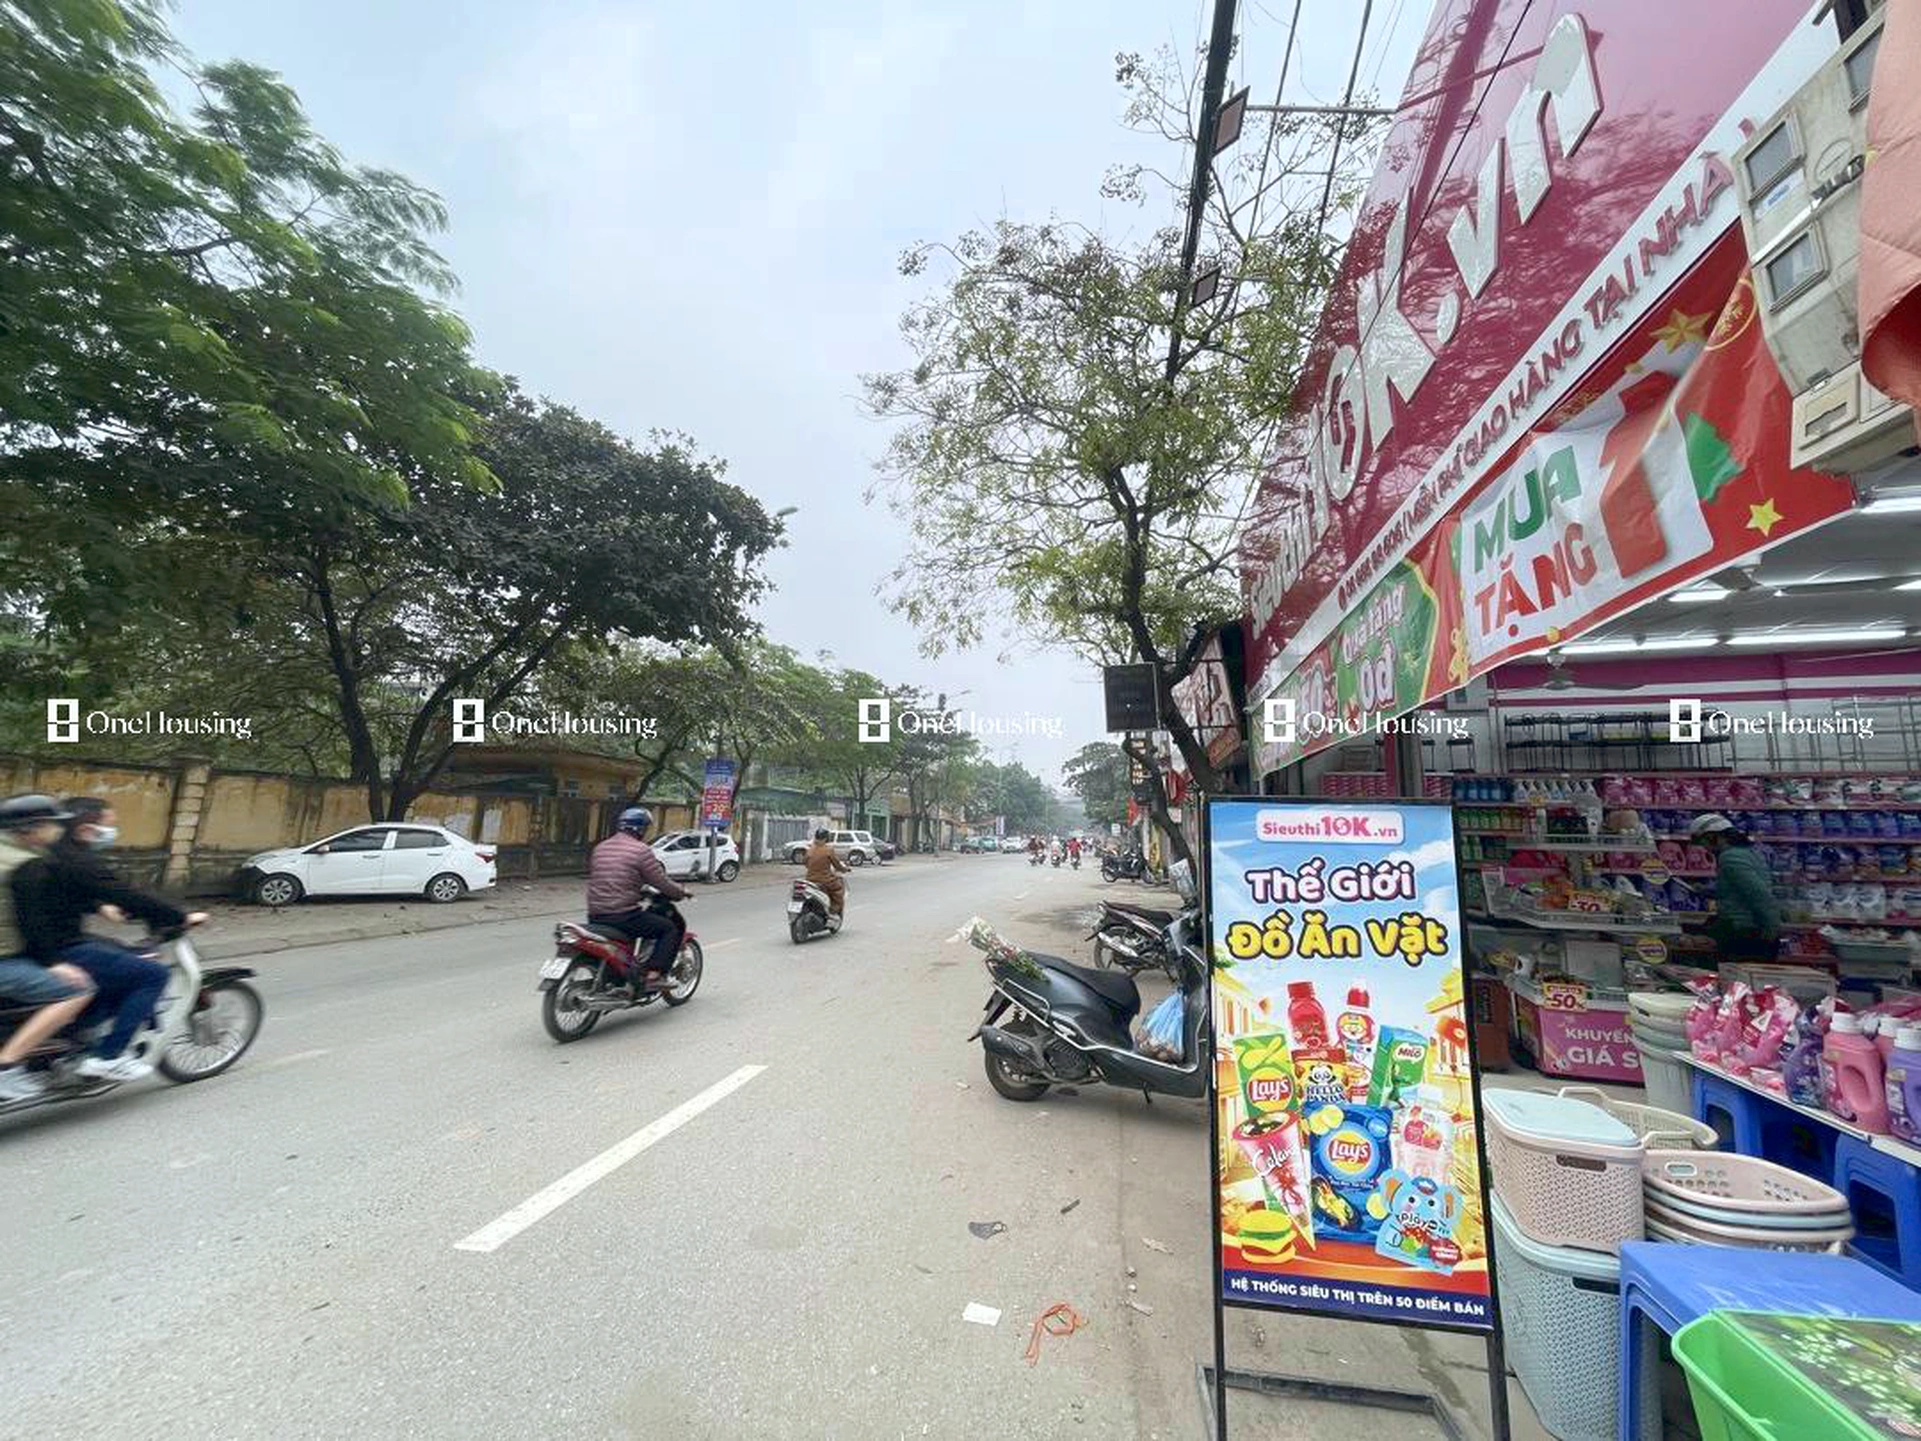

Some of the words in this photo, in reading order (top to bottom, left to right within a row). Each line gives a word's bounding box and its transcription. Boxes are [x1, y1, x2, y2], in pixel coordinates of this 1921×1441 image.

[1463, 403, 1509, 468] GIAO
[1508, 317, 1584, 420] HÀNG
[1582, 255, 1640, 330] TẠI
[1638, 151, 1735, 277] NHÀ
[1474, 445, 1582, 574] MUA
[1475, 522, 1598, 637] TẶNG
[1262, 816, 1398, 838] Sieuthi10K.vn
[1247, 858, 1325, 902] Thế
[1330, 861, 1415, 901] Giới
[1227, 910, 1292, 957] Đồ
[1299, 911, 1361, 957] Ăn
[1366, 913, 1448, 965] Vặt
[1566, 1045, 1616, 1067] GIÁ
[1231, 1277, 1249, 1292] HỆ
[1251, 1279, 1297, 1295] THỐNG
[1300, 1284, 1329, 1299] SIÊU
[1332, 1289, 1355, 1305] THỊ
[1357, 1291, 1393, 1306] TRÊN
[1396, 1297, 1412, 1308] 50
[1415, 1296, 1450, 1312] ĐIỂM
[1454, 1301, 1484, 1316] BÁN
